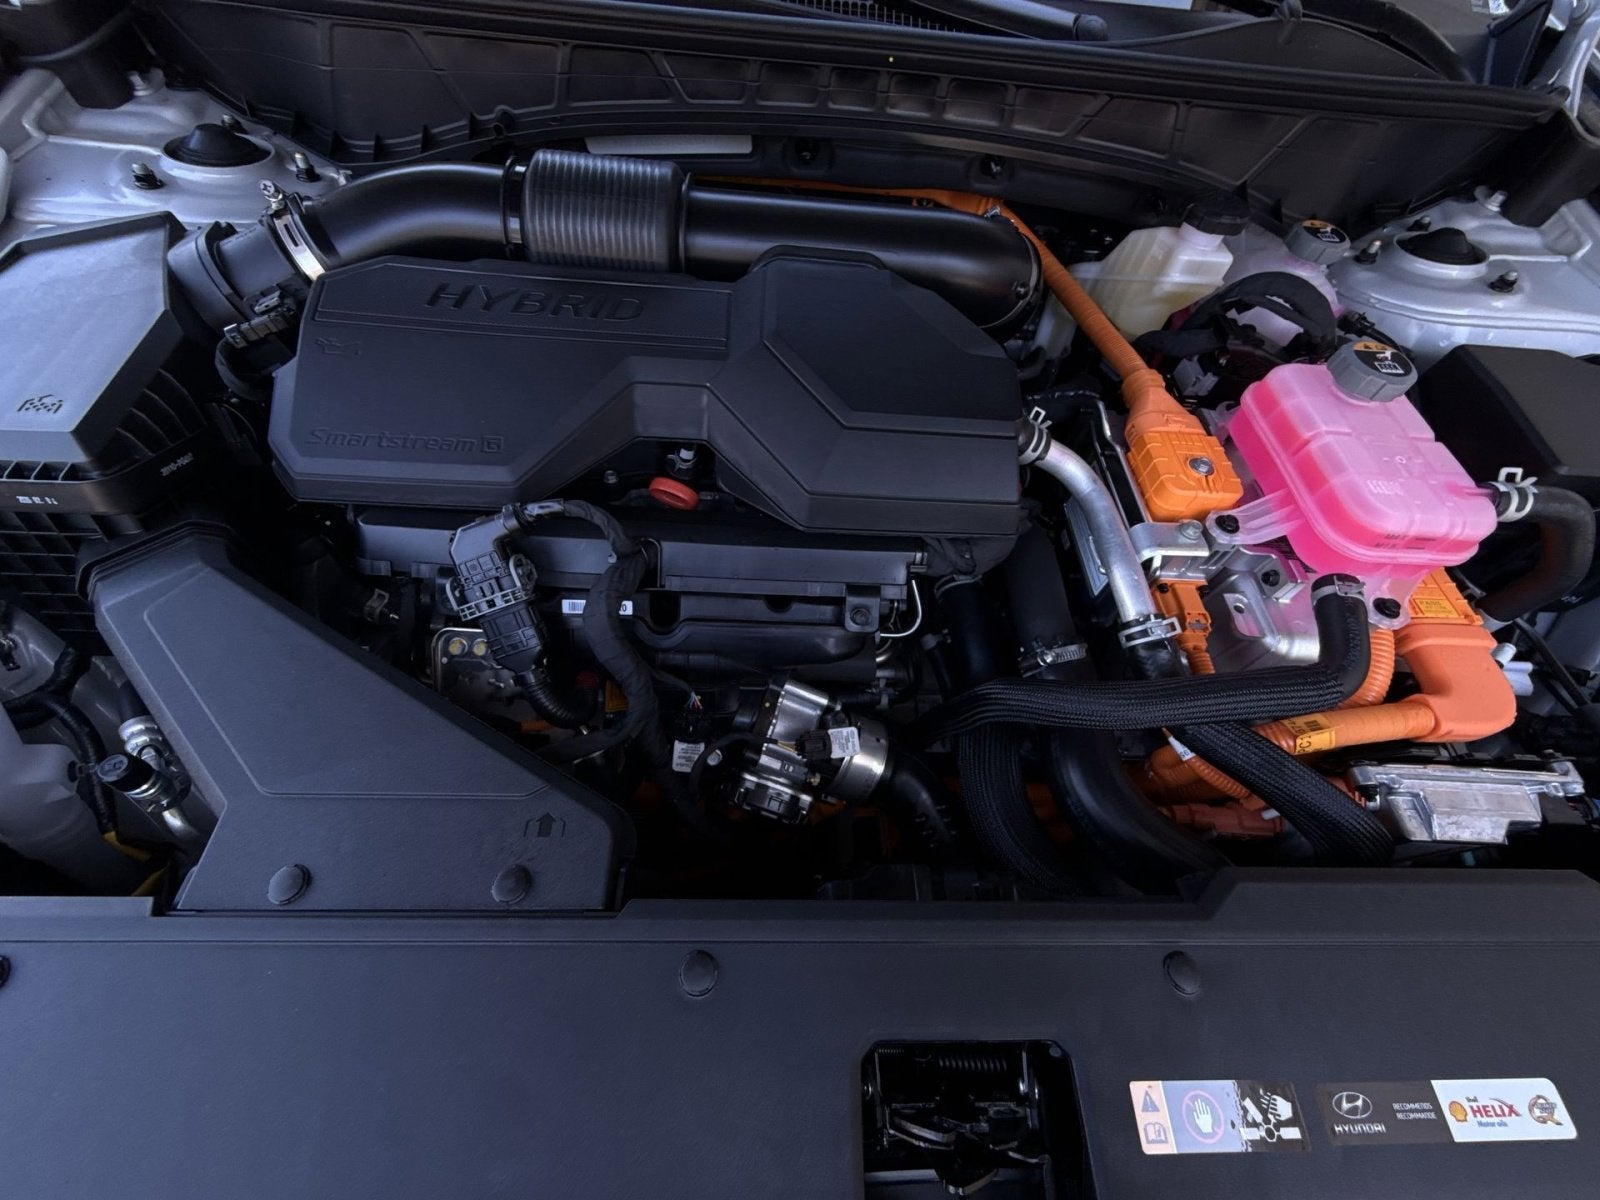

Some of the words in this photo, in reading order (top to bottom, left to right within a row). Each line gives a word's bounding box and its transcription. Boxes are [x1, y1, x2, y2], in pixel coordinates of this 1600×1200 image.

[424, 282, 644, 322] HYBRID
[305, 427, 477, 452] Smartstream
[1392, 1102, 1433, 1111] RECOMMENDS
[1469, 1103, 1522, 1118] HELIX
[1396, 1111, 1438, 1120] RECOMMANDE
[1333, 1123, 1387, 1134] HYUNDAI
